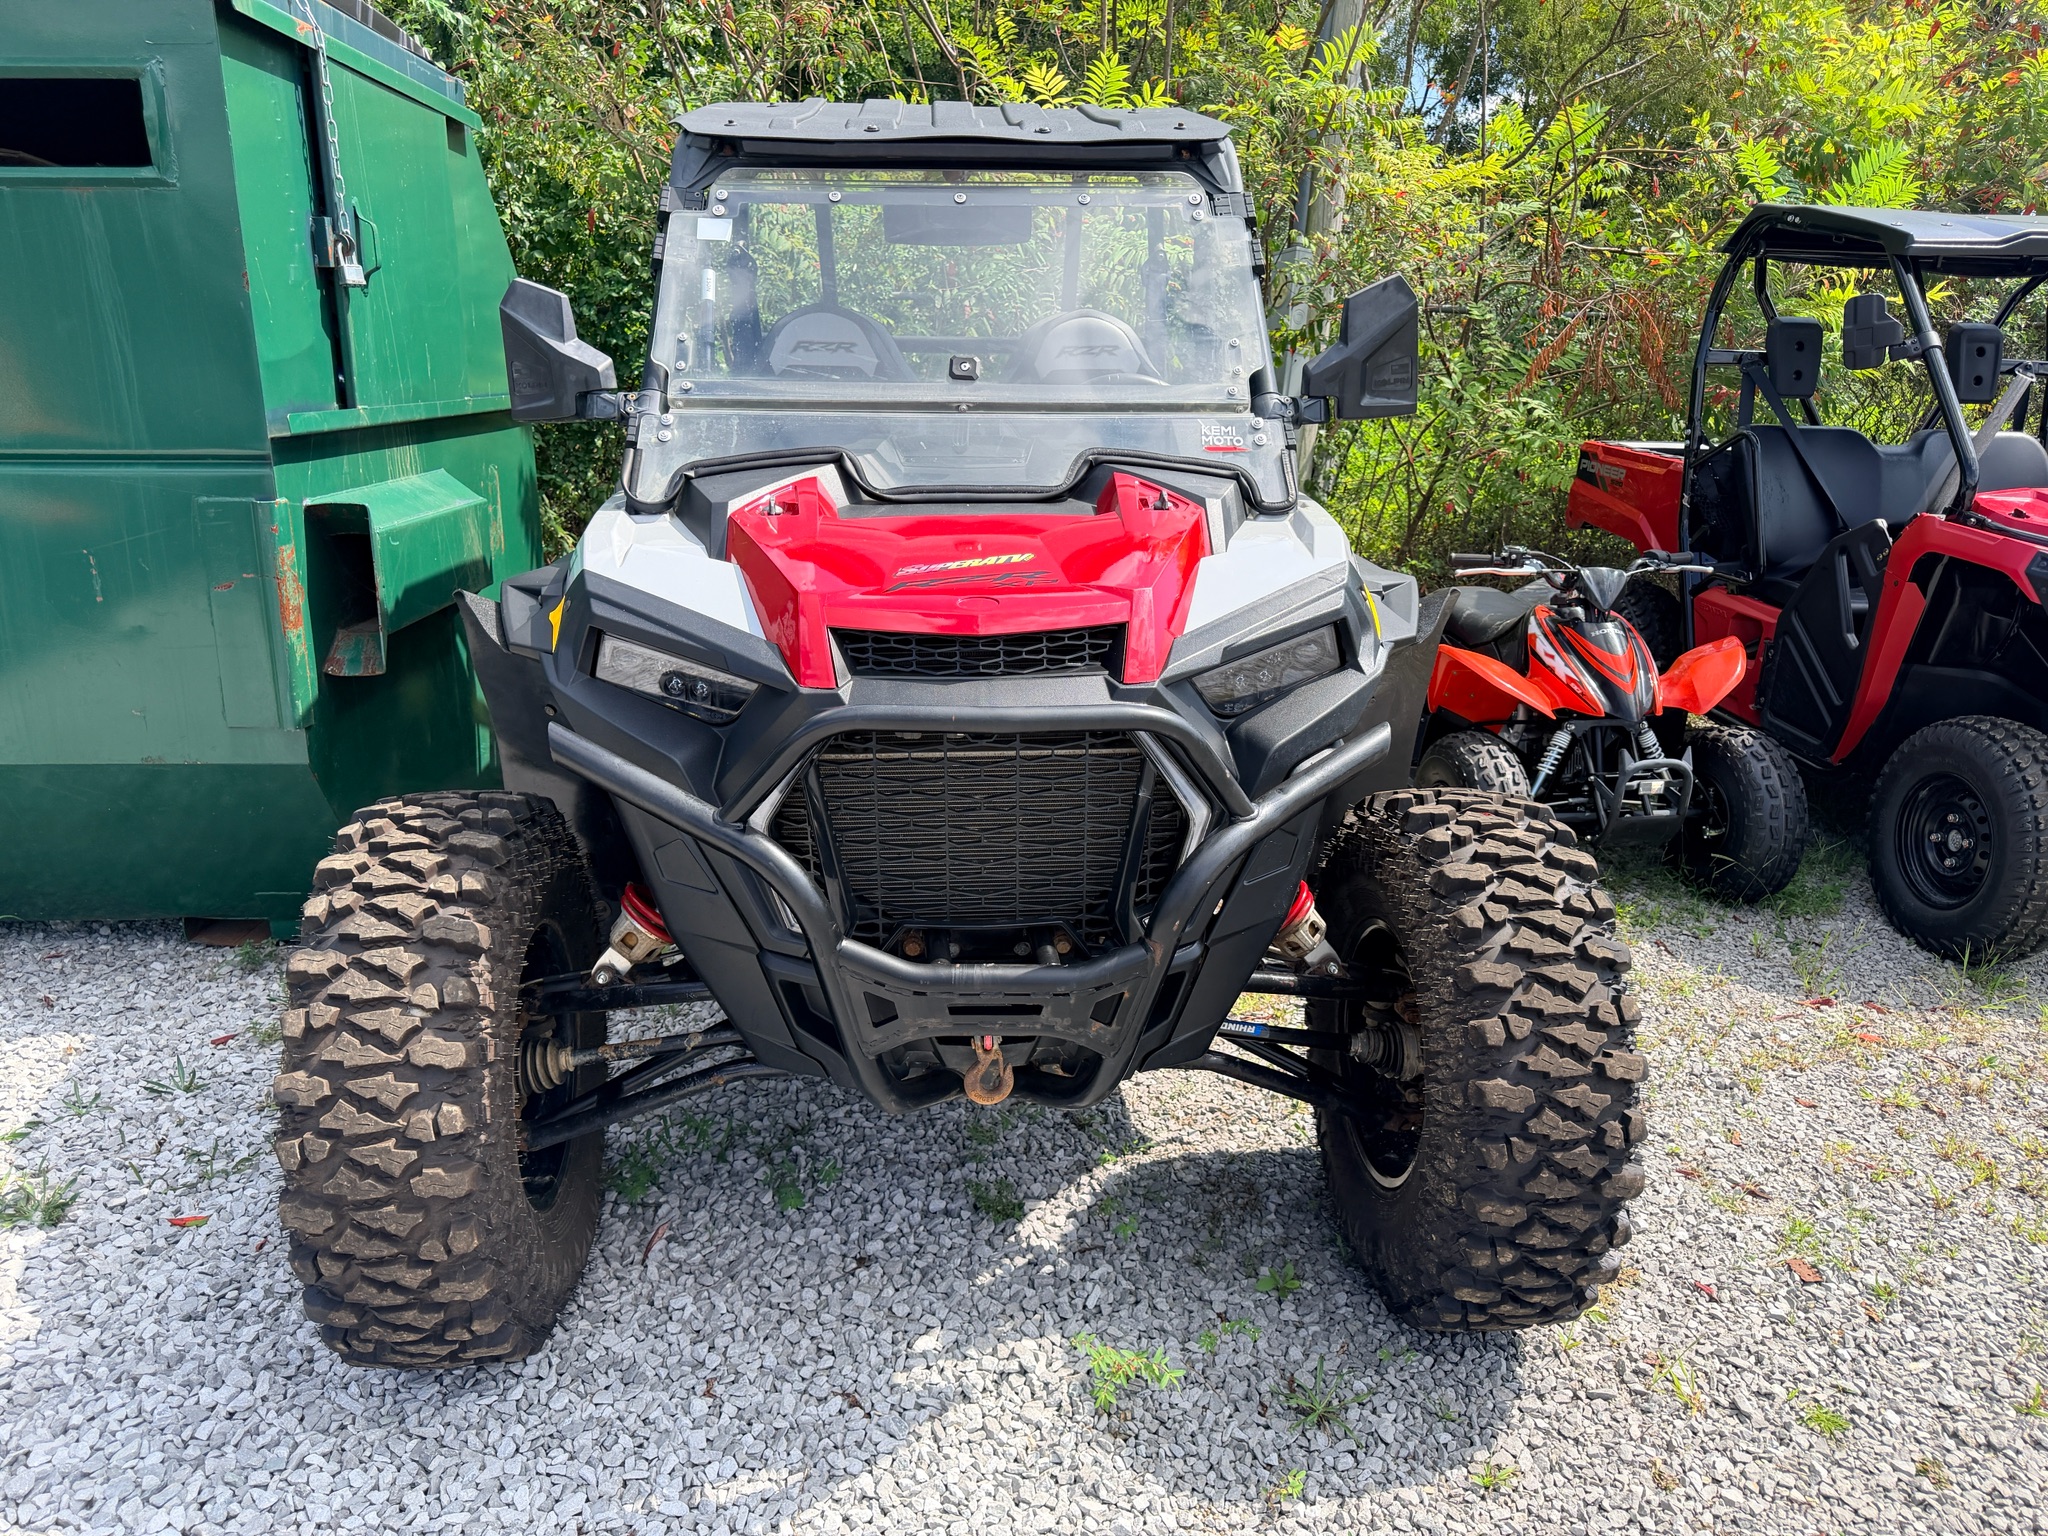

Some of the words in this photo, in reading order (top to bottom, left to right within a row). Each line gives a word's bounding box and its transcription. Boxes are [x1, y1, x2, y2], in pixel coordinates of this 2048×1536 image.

[789, 341, 858, 354] RZR
[1054, 345, 1121, 358] RZR
[1201, 425, 1236, 436] KEMI
[1201, 436, 1243, 446] MOTO
[1580, 459, 1626, 480] PIONEER
[882, 570, 1052, 593] RZR
[988, 579, 1059, 589] XP
[1590, 628, 1626, 637] HONDA
